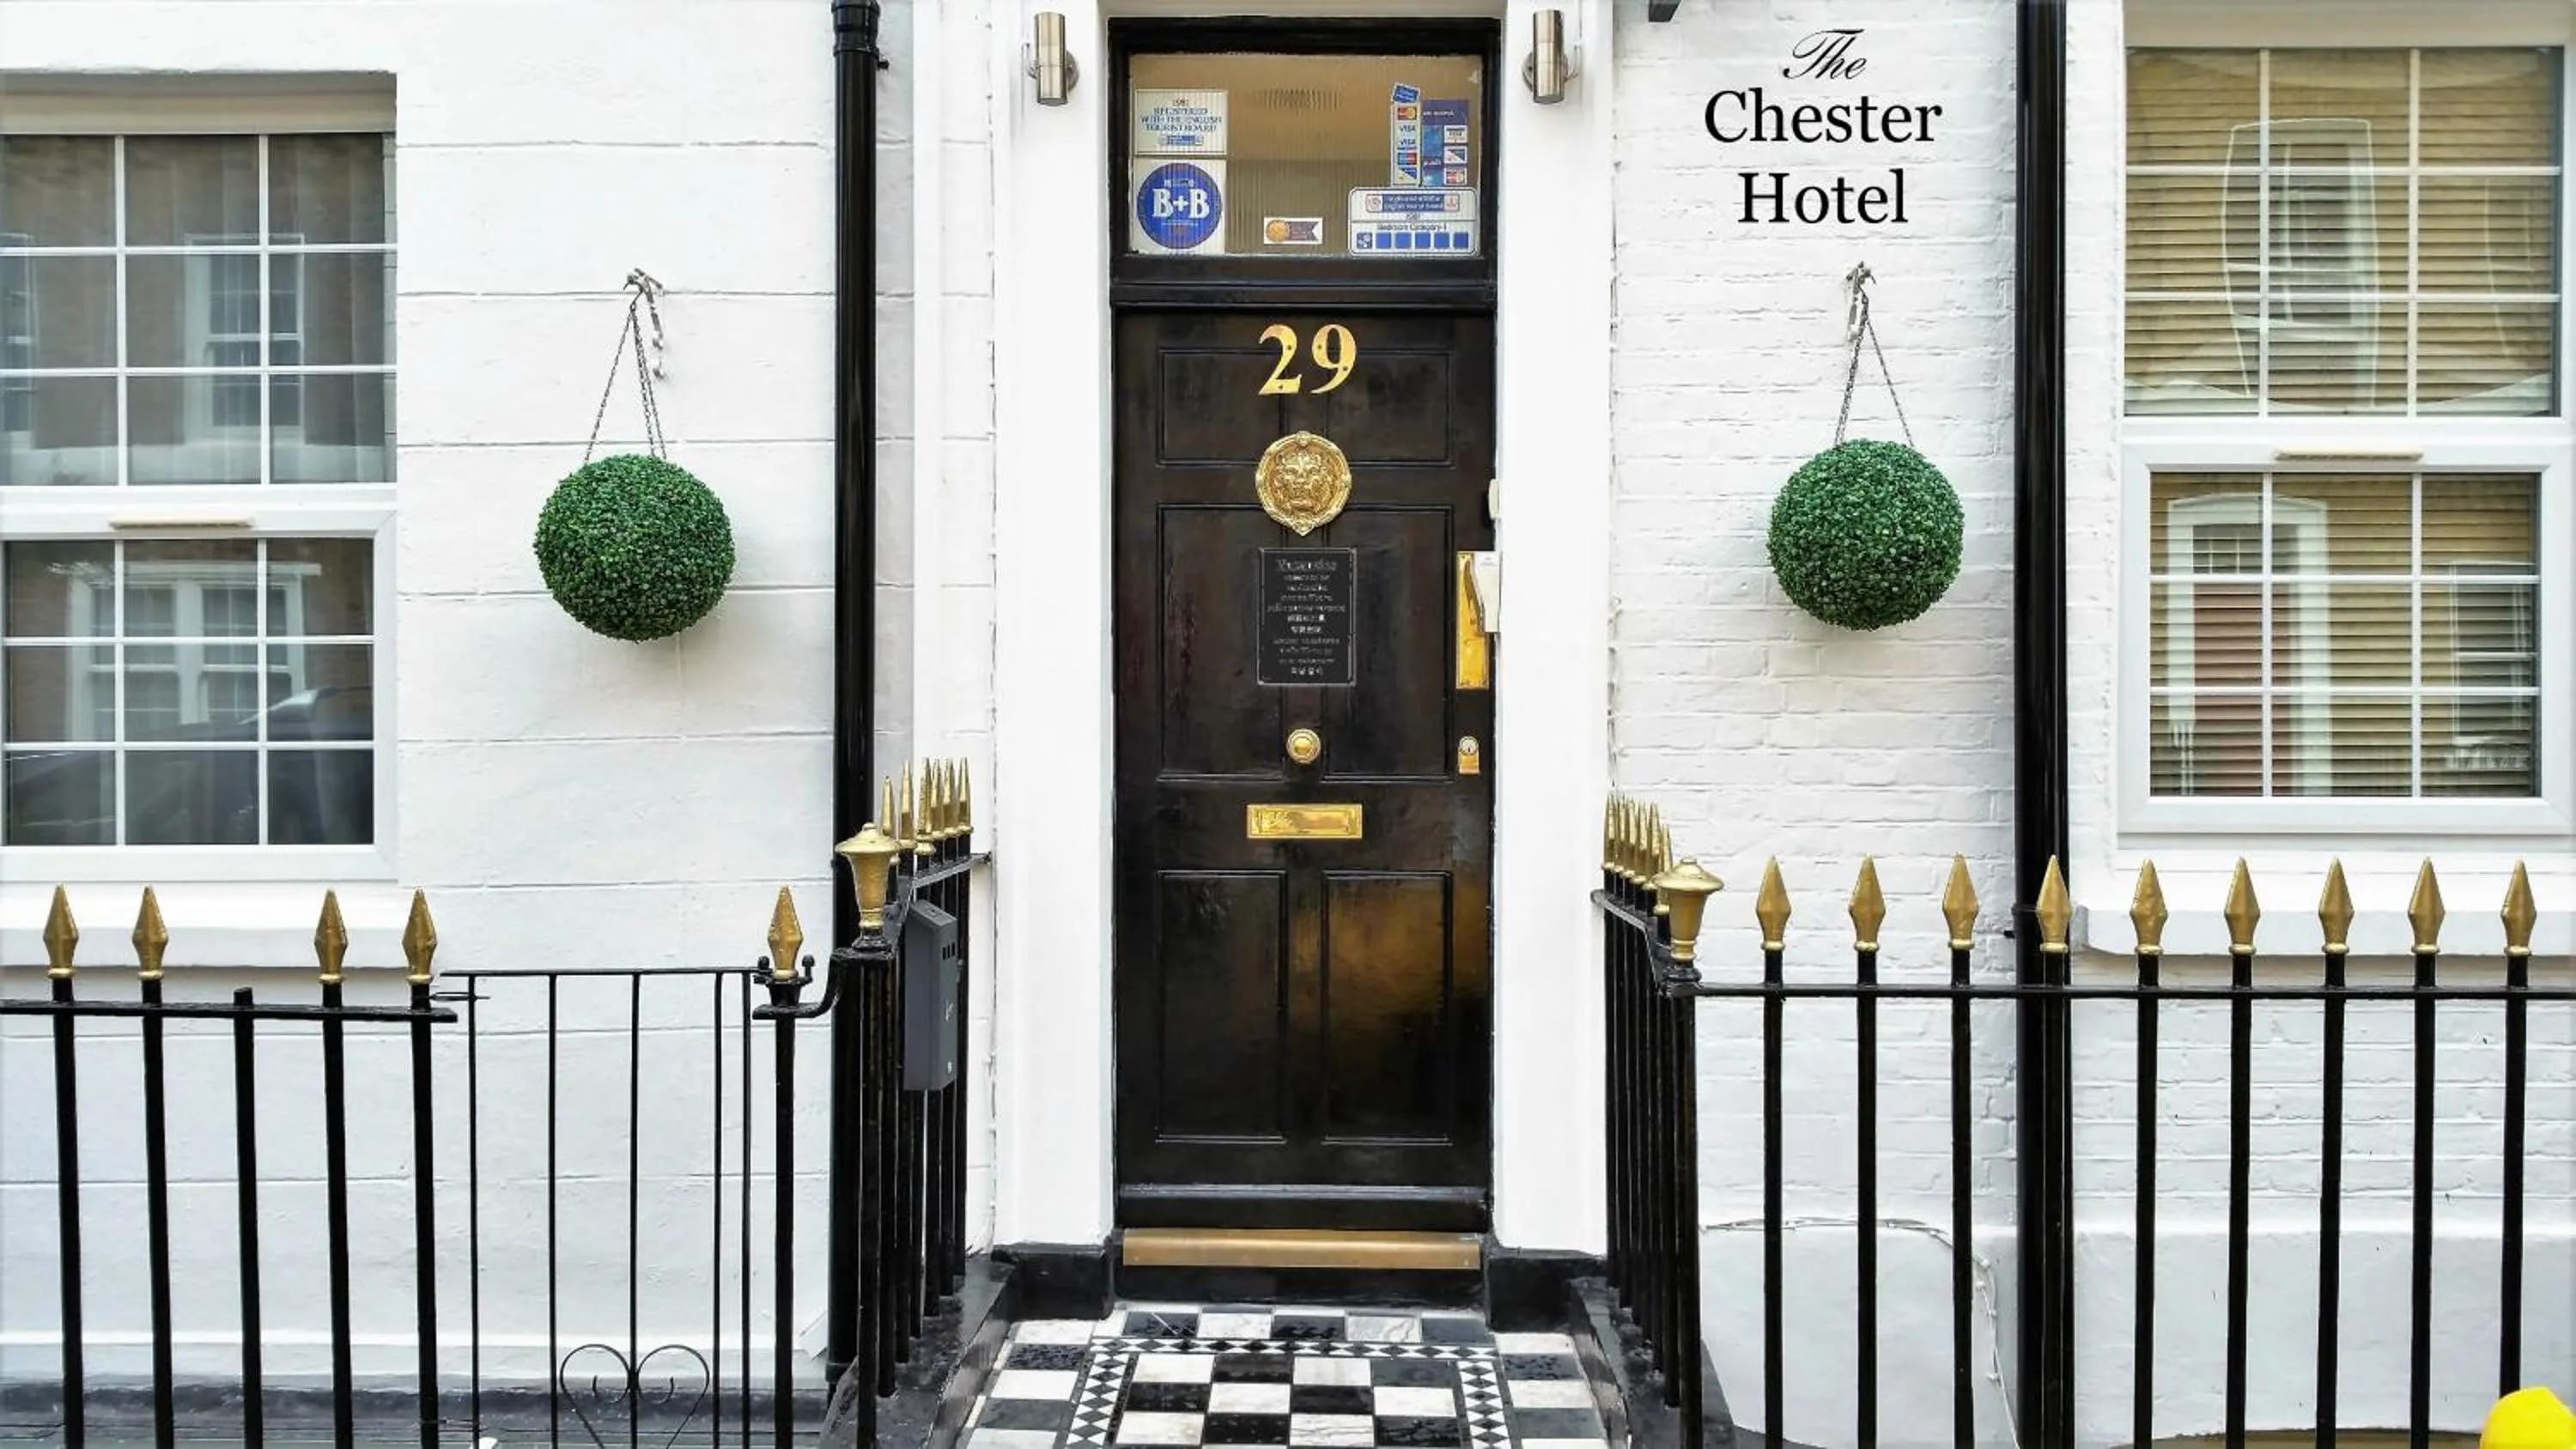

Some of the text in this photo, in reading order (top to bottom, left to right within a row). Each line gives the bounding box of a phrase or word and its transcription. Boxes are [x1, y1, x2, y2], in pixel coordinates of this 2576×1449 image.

[1783, 28, 1868, 80] The
[1704, 87, 1943, 143] Chester
[1151, 188, 1210, 220] B+B
[1737, 168, 1909, 224] Hotel
[1258, 324, 1356, 395] 29
